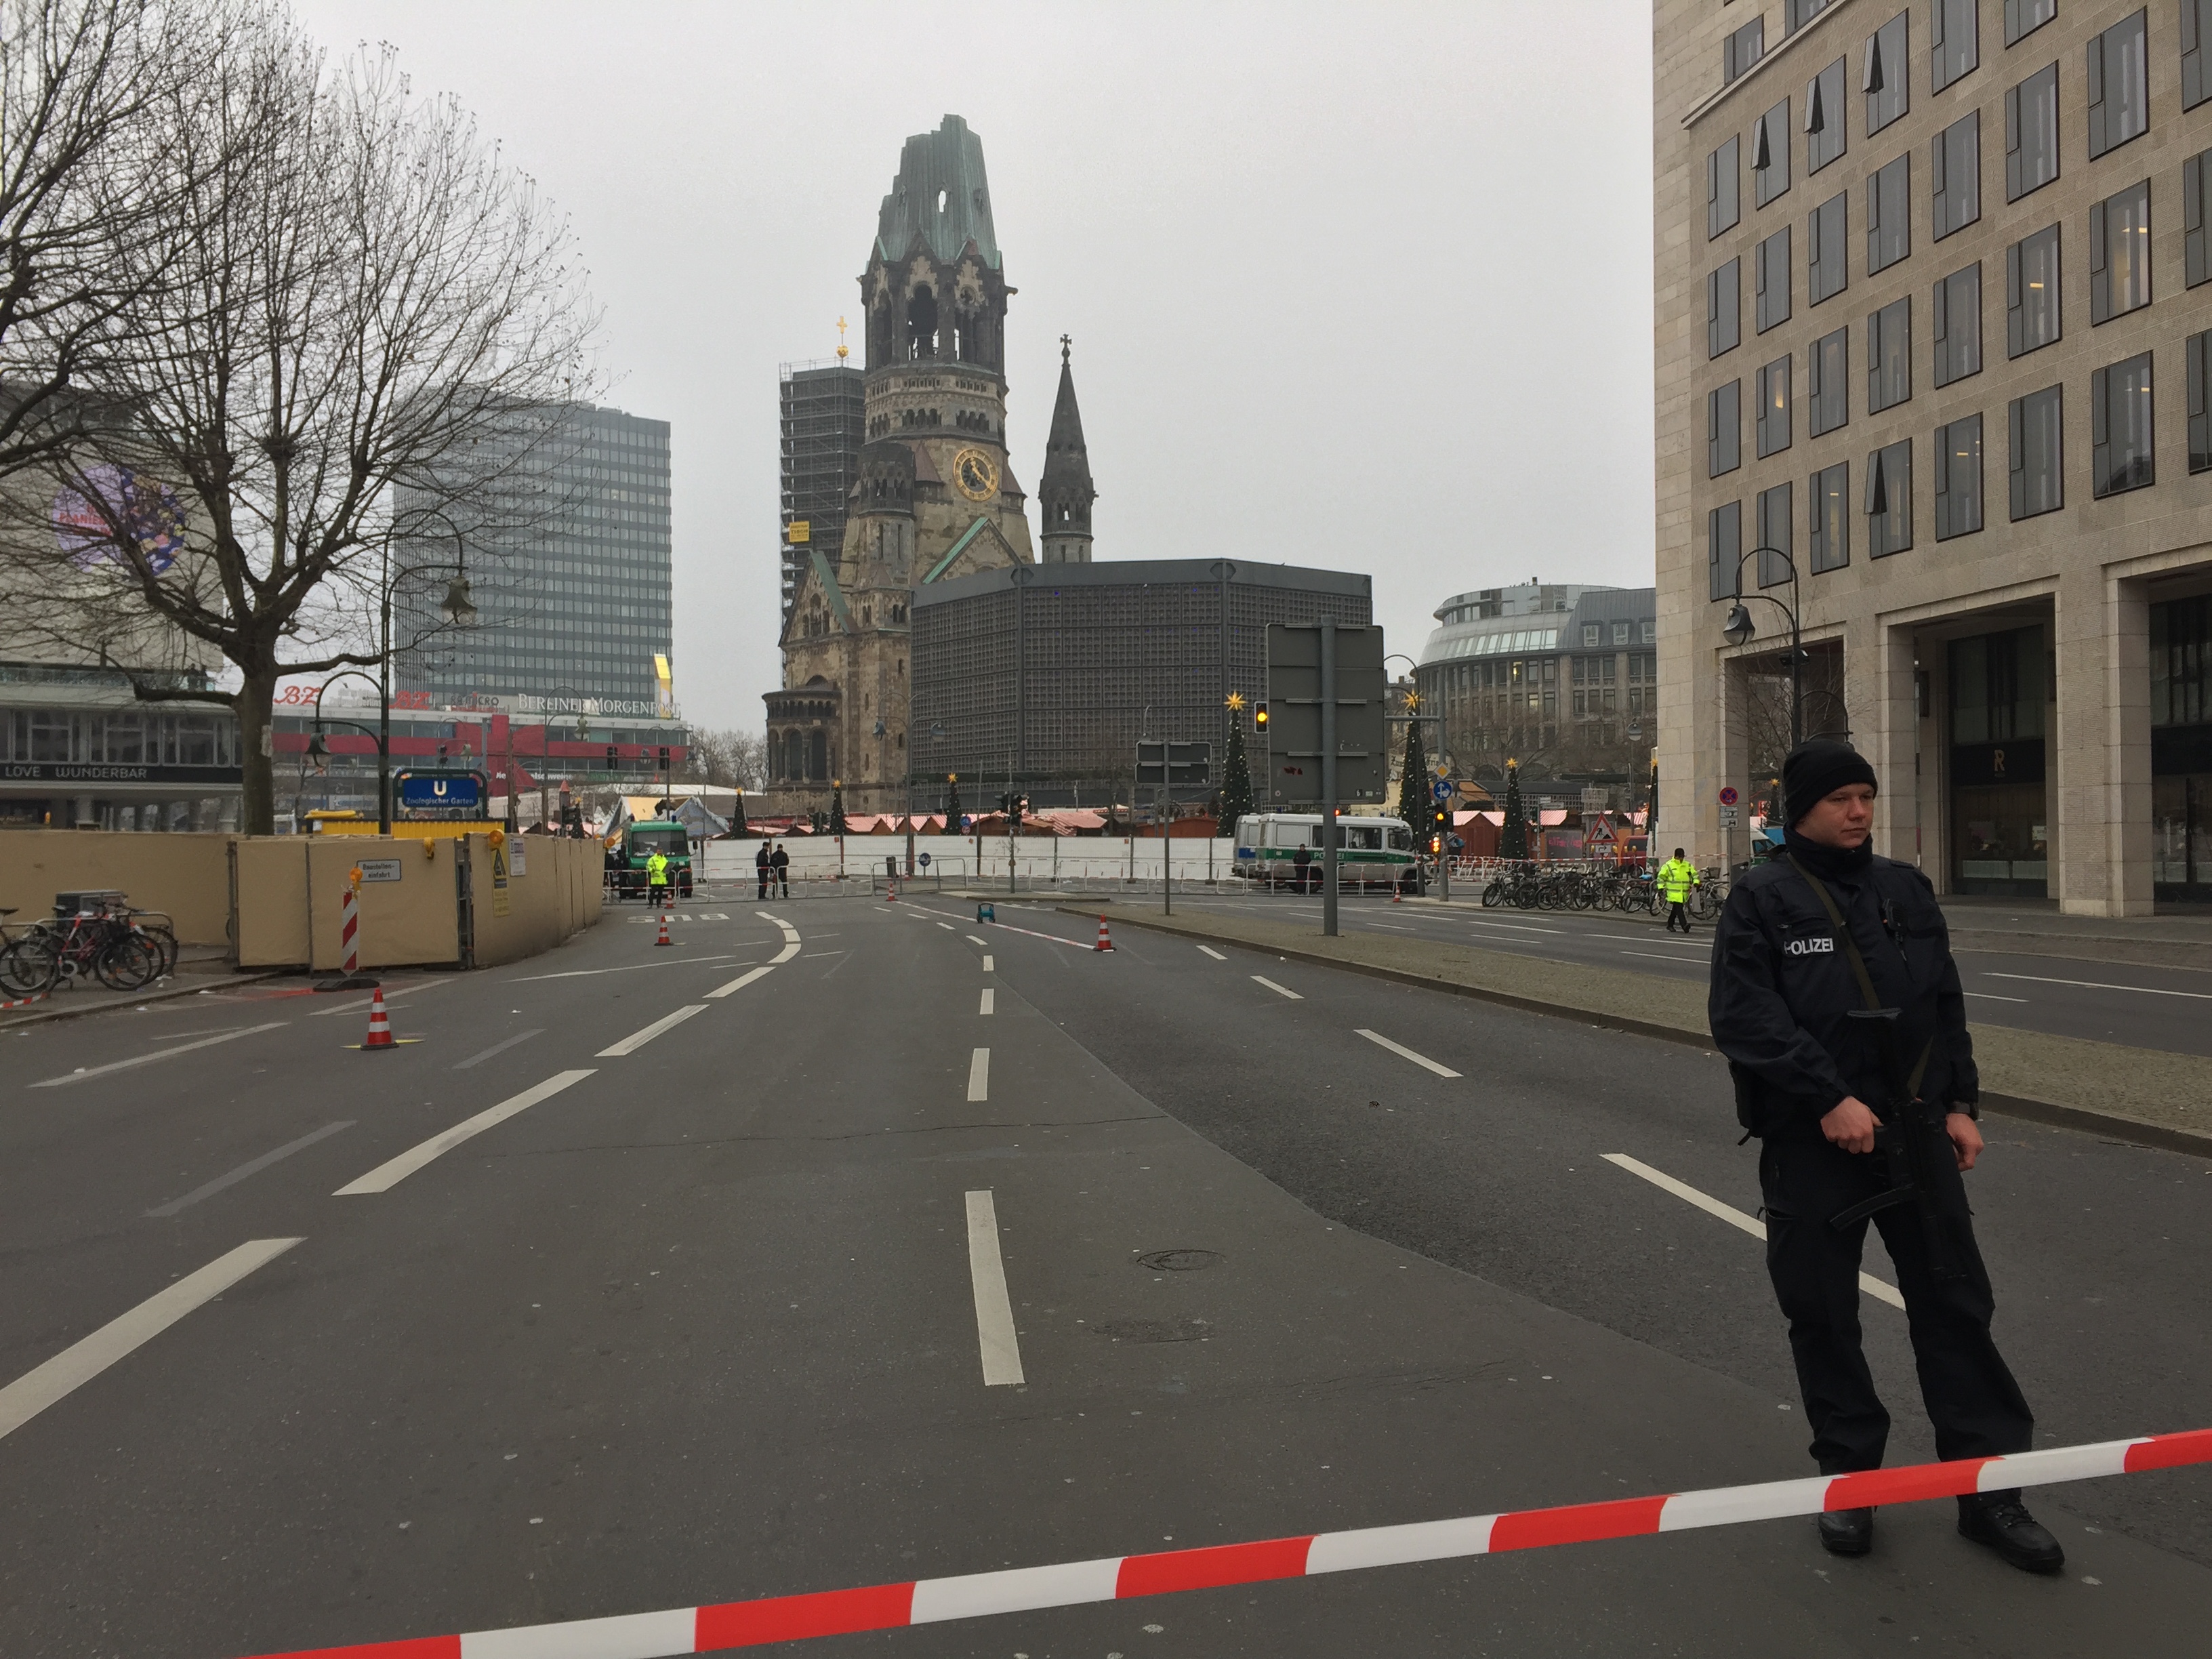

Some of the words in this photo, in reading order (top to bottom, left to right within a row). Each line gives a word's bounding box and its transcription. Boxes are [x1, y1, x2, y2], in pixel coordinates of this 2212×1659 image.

[518, 693, 585, 713] BERLINER
[590, 697, 681, 716] MORGENPOST
[5, 766, 41, 777] LOVE
[55, 766, 147, 779] WUNDERBAR
[434, 781, 447, 796] U
[406, 797, 449, 806] Zoologischer
[1313, 851, 1345, 859] POEI
